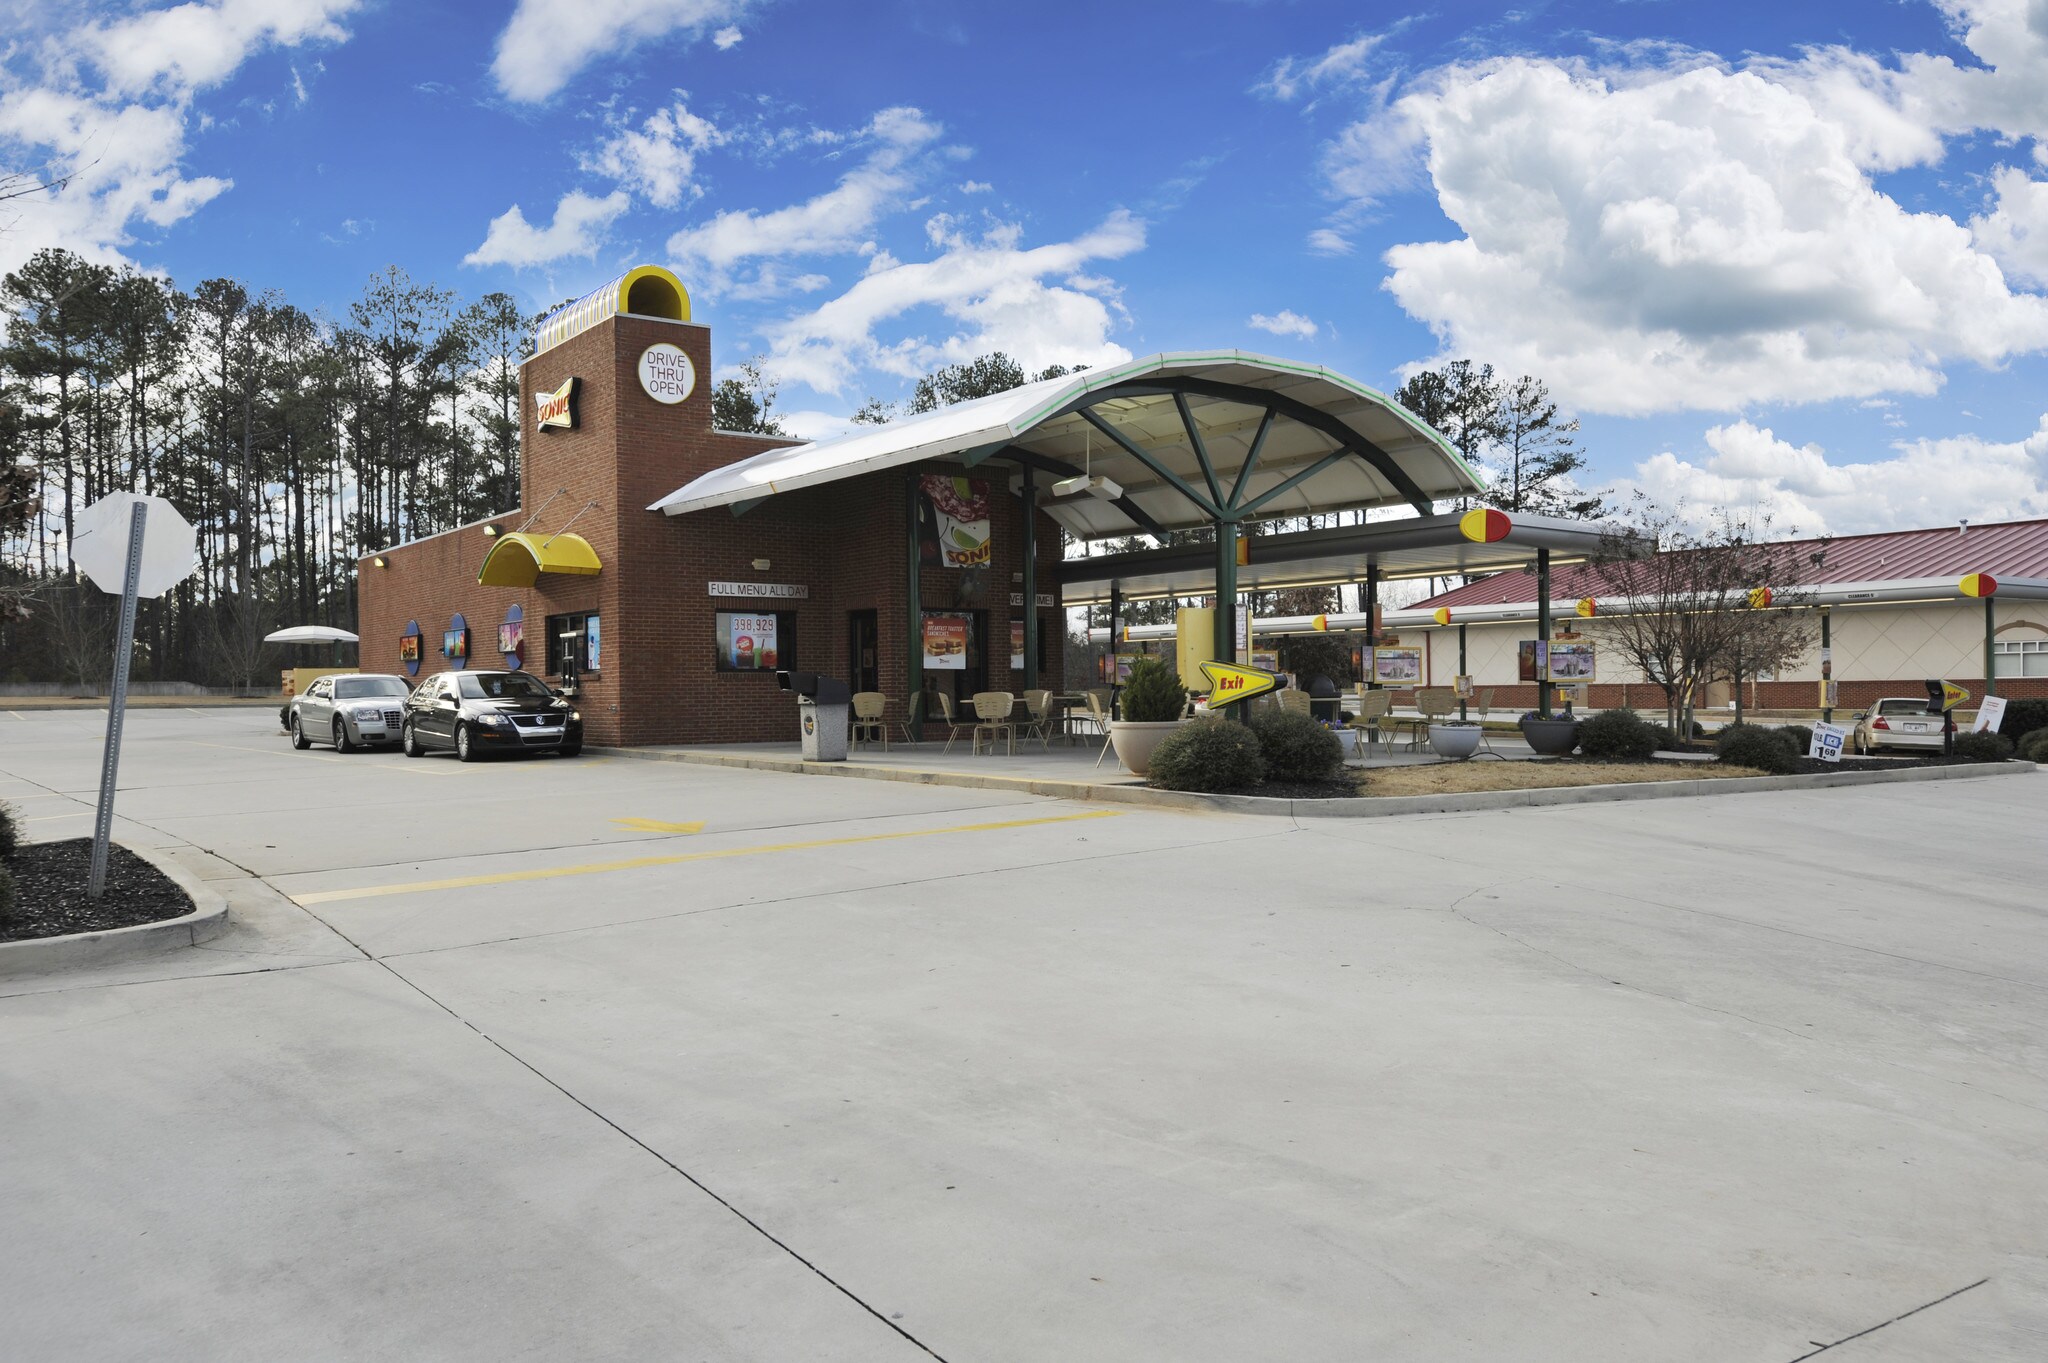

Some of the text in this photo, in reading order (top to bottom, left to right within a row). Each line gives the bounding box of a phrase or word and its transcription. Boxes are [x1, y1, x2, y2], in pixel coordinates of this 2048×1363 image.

[647, 351, 686, 368] DRIVE
[649, 366, 684, 382] THRU
[649, 380, 685, 396] OPEN
[537, 393, 570, 423] SONIC
[946, 545, 989, 565] SONI
[711, 583, 807, 597] FULL MENU ALL DAY
[1036, 595, 1053, 605] IME!
[734, 618, 774, 632] 398,929
[1219, 675, 1244, 690] Exit
[1946, 691, 1961, 700] Enter
